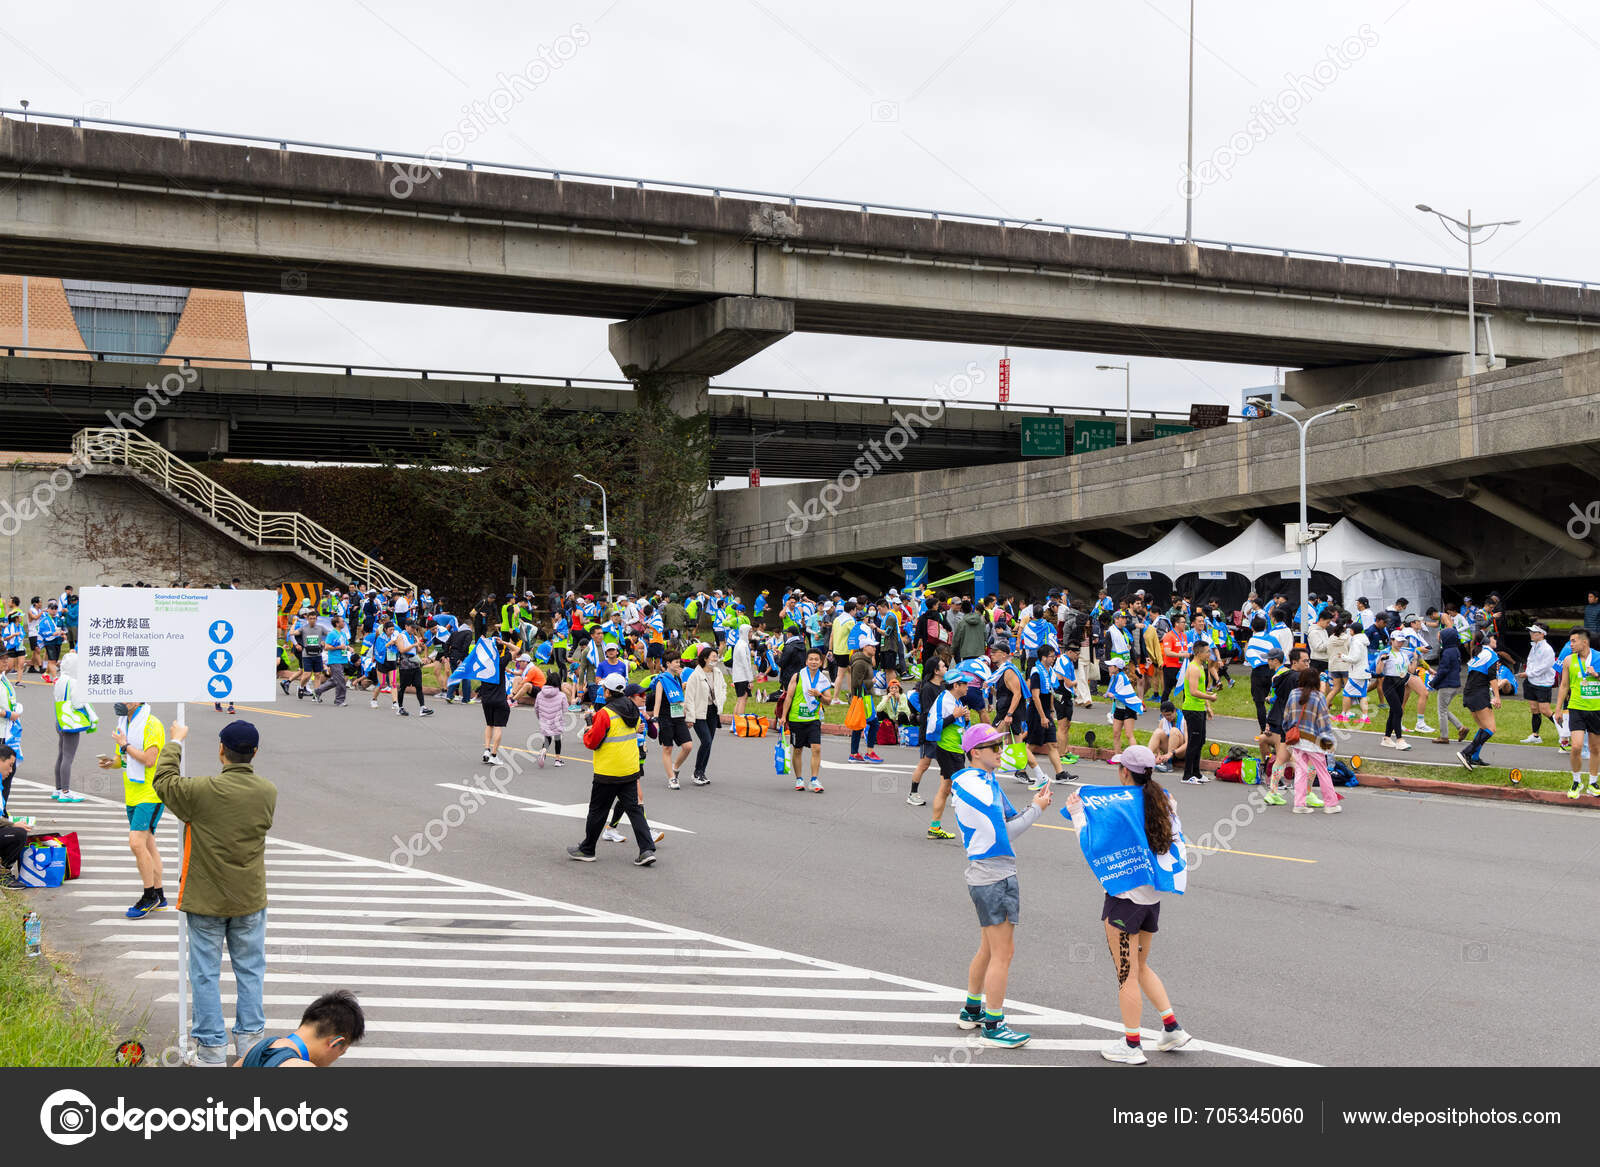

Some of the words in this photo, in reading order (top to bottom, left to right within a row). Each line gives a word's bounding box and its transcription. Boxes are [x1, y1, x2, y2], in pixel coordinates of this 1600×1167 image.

[89, 617, 151, 629] 冰池放鬆區
[89, 632, 102, 640] Ice
[103, 632, 121, 640] Pool
[122, 632, 165, 640] Relaxation
[166, 632, 185, 640] Area
[88, 645, 150, 657] 獎牌雷雕區
[88, 660, 114, 668] Medal
[116, 660, 156, 669] Engraving
[88, 673, 125, 685] 接駁車
[88, 688, 117, 696] Shuttle
[119, 688, 133, 696] Bus
[1107, 855, 1141, 871] Marathon
